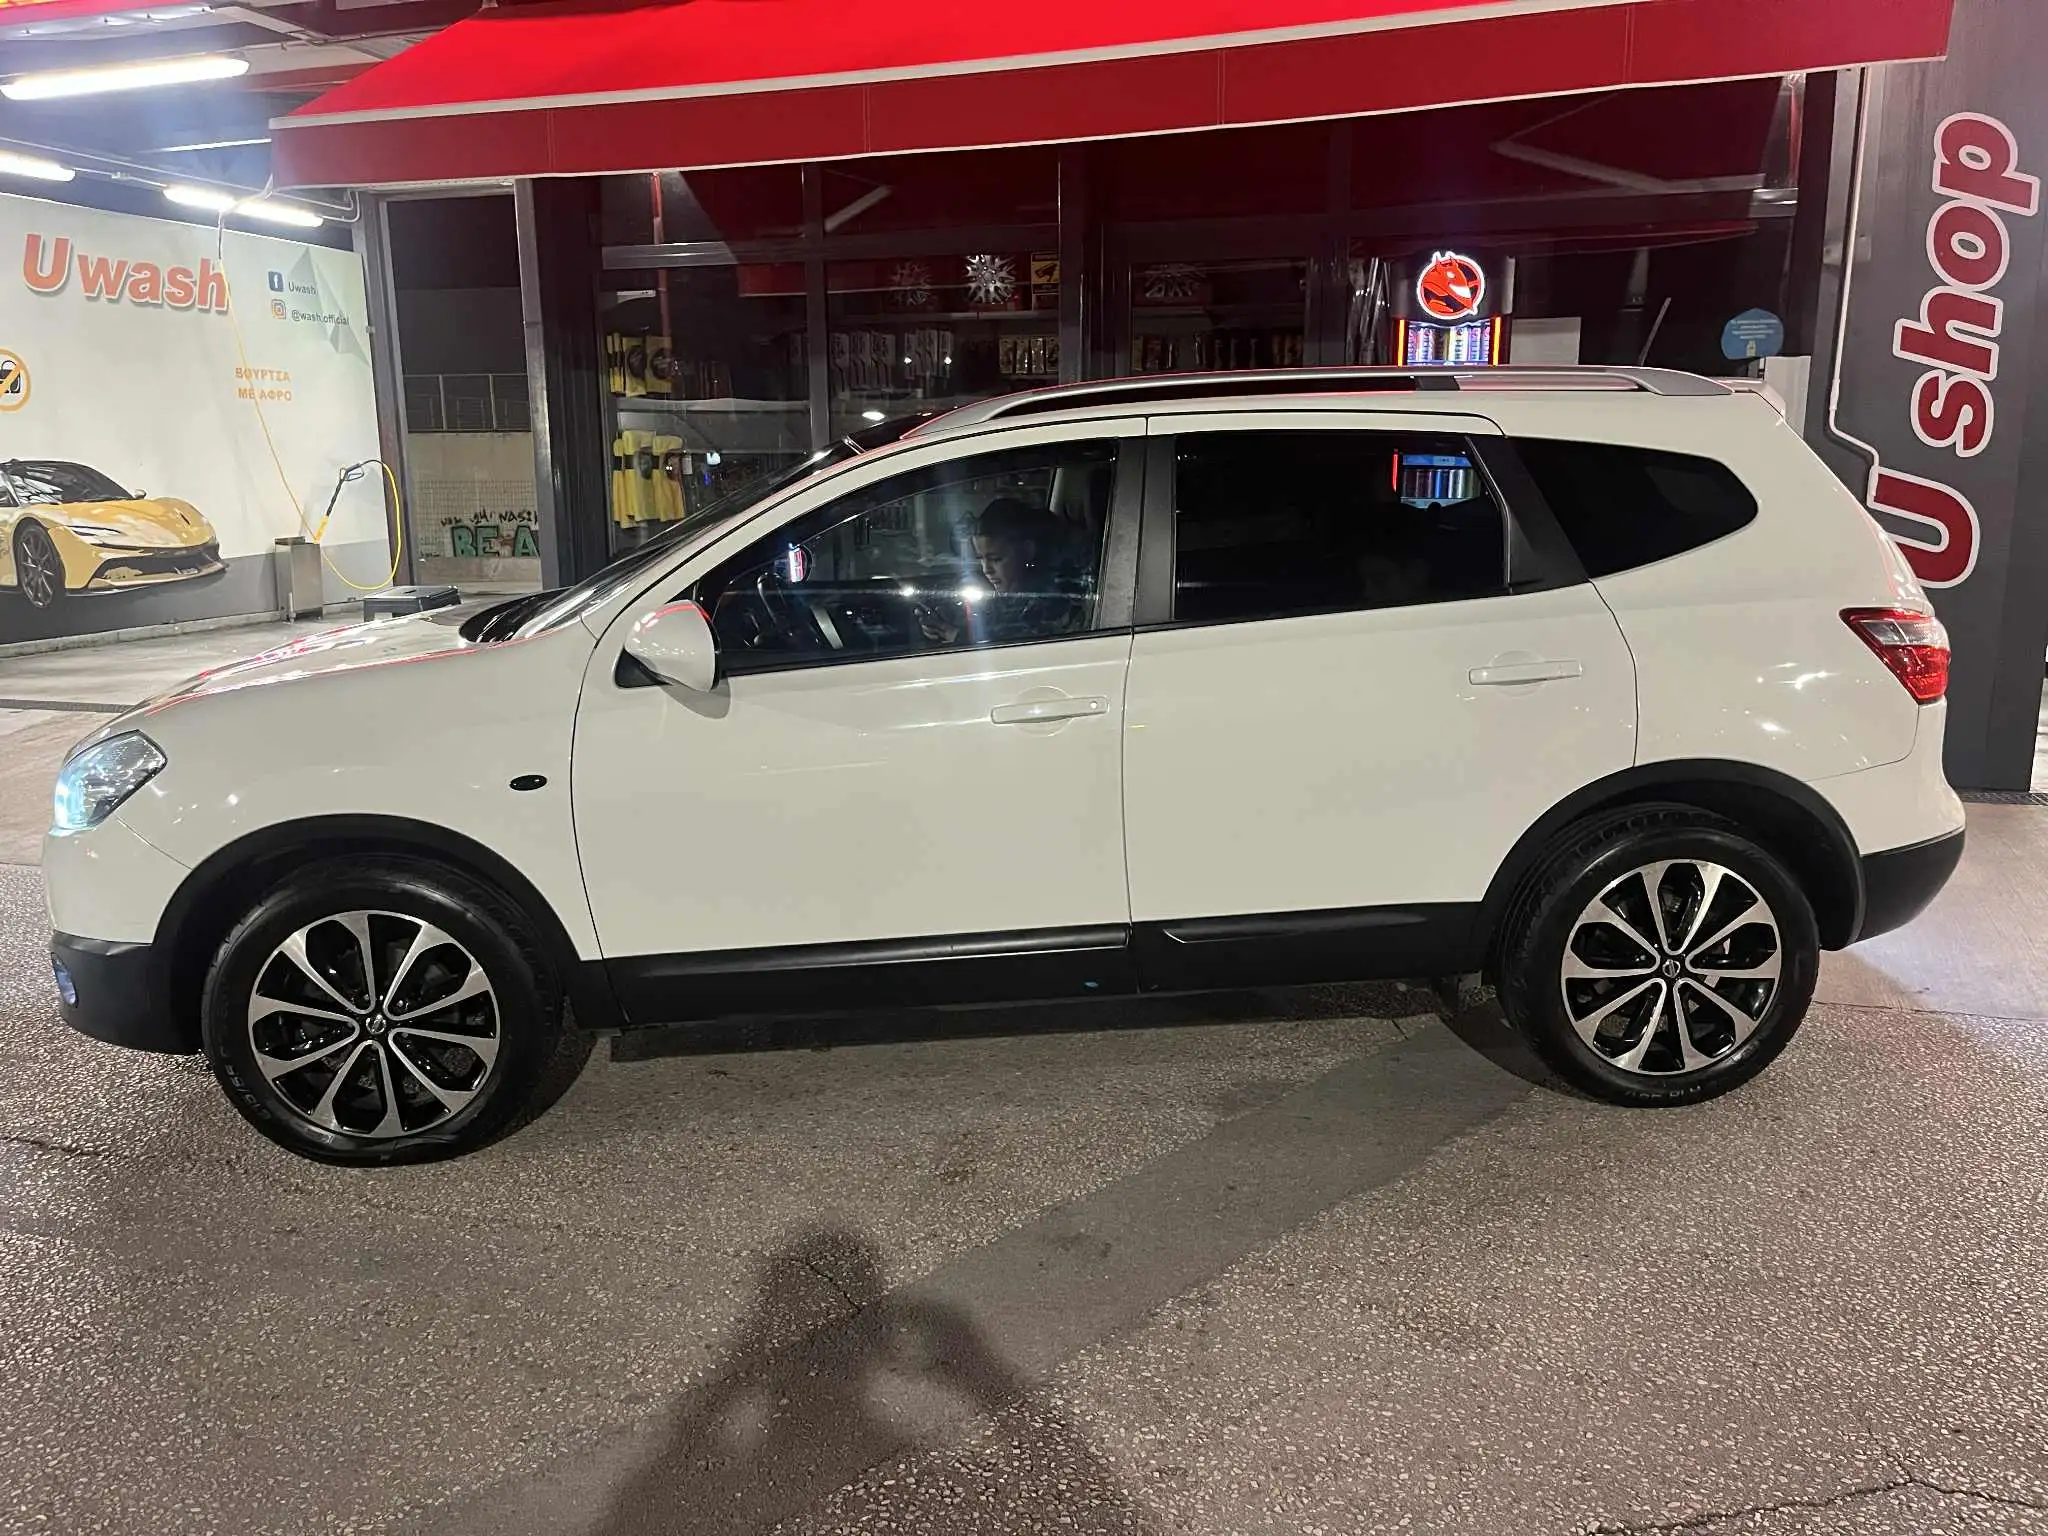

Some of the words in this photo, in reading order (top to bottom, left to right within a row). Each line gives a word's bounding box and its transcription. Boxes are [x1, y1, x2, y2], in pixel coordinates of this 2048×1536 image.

[1893, 111, 2041, 458] shop
[238, 387, 255, 400] ΜΕ
[258, 389, 292, 402] ΑΦΡΟ
